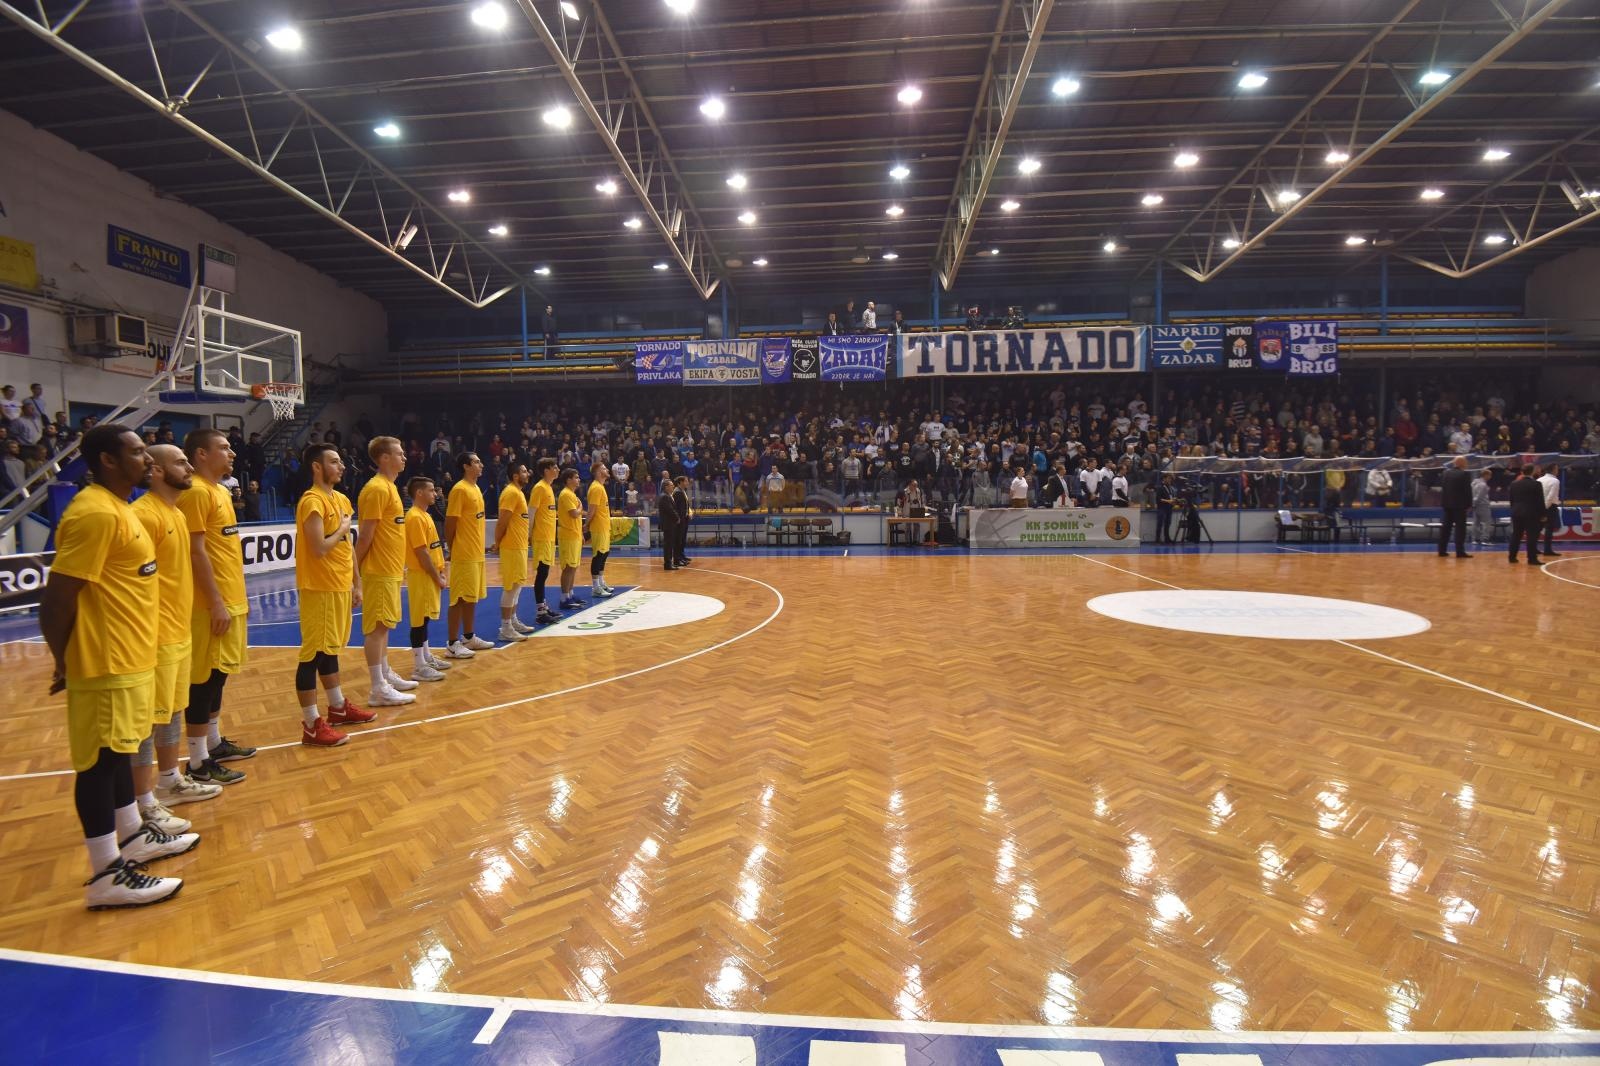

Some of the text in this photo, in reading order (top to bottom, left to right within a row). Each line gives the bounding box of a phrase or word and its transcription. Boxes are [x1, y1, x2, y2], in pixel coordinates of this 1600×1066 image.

[117, 233, 179, 266] FRANTO
[1156, 326, 1220, 337] NAPRID
[1289, 323, 1337, 340] BILI
[636, 342, 681, 352] TORNADO
[686, 341, 757, 362] TORNADO
[908, 330, 1135, 373] TORNADO
[707, 356, 737, 364] ZADAR
[820, 344, 886, 372] ZADAR
[1160, 353, 1216, 365] ZADAR
[1289, 357, 1337, 373] BRIG
[637, 371, 682, 380] PRIVLAKA
[689, 369, 760, 379] EKIPA VOSTA
[1026, 520, 1080, 530] KK SONIK
[1019, 532, 1087, 542] PUNTAMIKA
[241, 533, 297, 565] CRO
